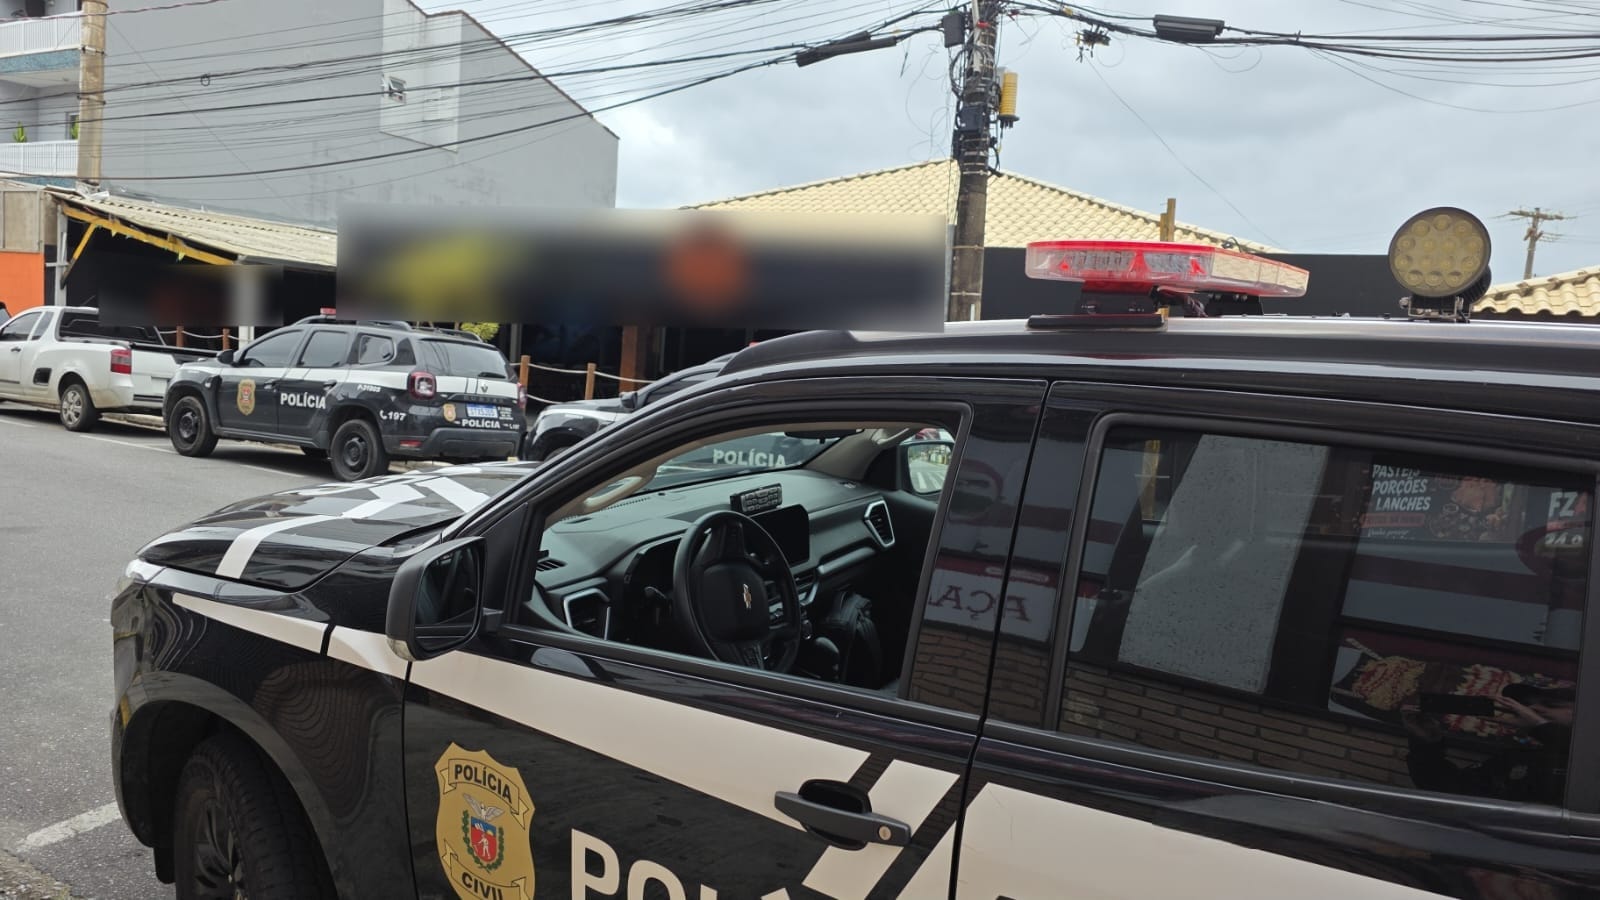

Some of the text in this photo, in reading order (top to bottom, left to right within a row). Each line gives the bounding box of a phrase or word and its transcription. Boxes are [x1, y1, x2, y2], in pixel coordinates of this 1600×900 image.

[280, 392, 326, 409] POLÍCIA
[387, 411, 406, 421] 197
[462, 418, 500, 429] POLÍCIA
[713, 448, 786, 467] POLÍCIA
[1372, 477, 1428, 496] PORÇÕES
[1375, 496, 1432, 511] LANCHES
[454, 763, 513, 804] POLÍCIA
